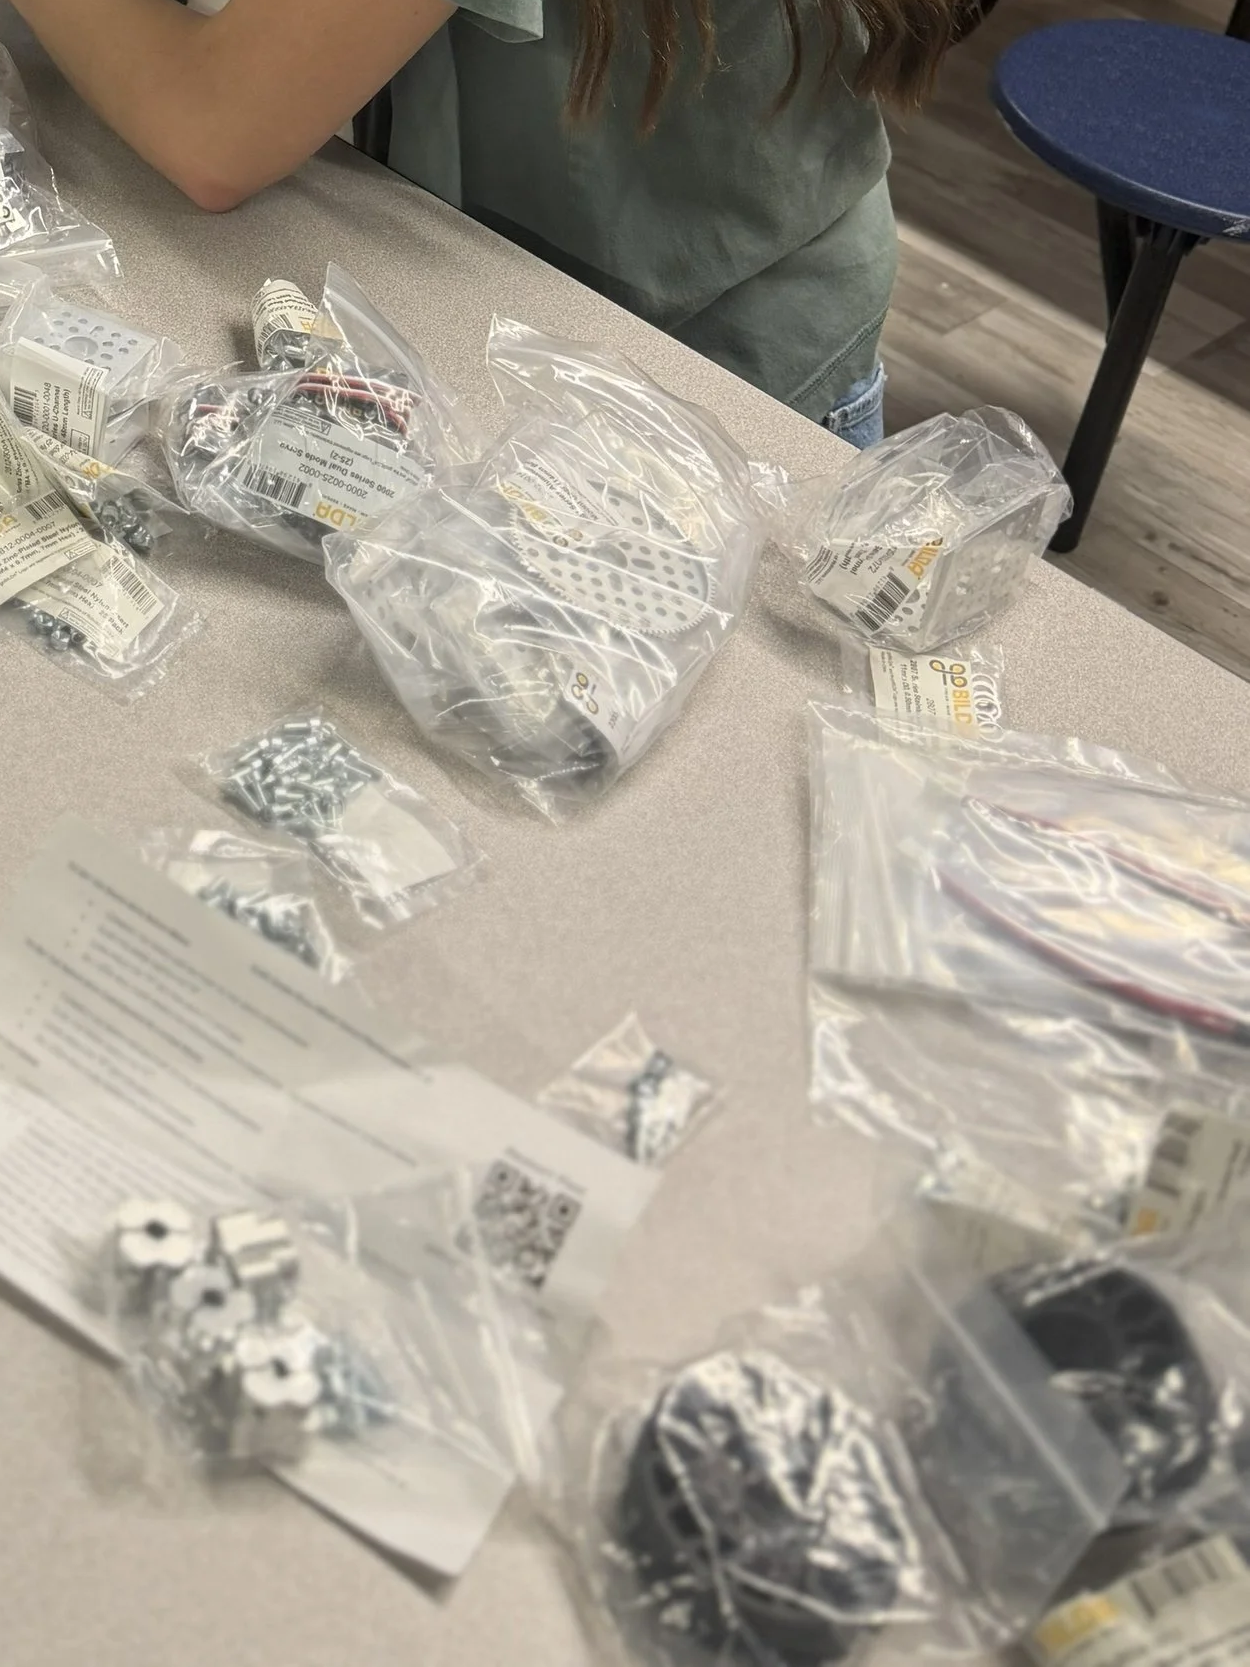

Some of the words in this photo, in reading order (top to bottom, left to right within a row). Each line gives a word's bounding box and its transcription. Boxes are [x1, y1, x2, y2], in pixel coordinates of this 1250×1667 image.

[51, 384, 61, 422] U-Channel
[61, 387, 71, 416] Length)
[276, 440, 304, 459] Servo
[302, 449, 328, 468] Mode
[327, 448, 355, 467] (25-2)
[326, 460, 349, 477] Dual
[296, 461, 368, 500] 2000-0025-0002
[347, 470, 377, 489] Series
[374, 482, 396, 499] 2000
[0, 537, 42, 565] Zinc-Plated
[40, 528, 60, 543] Steel
